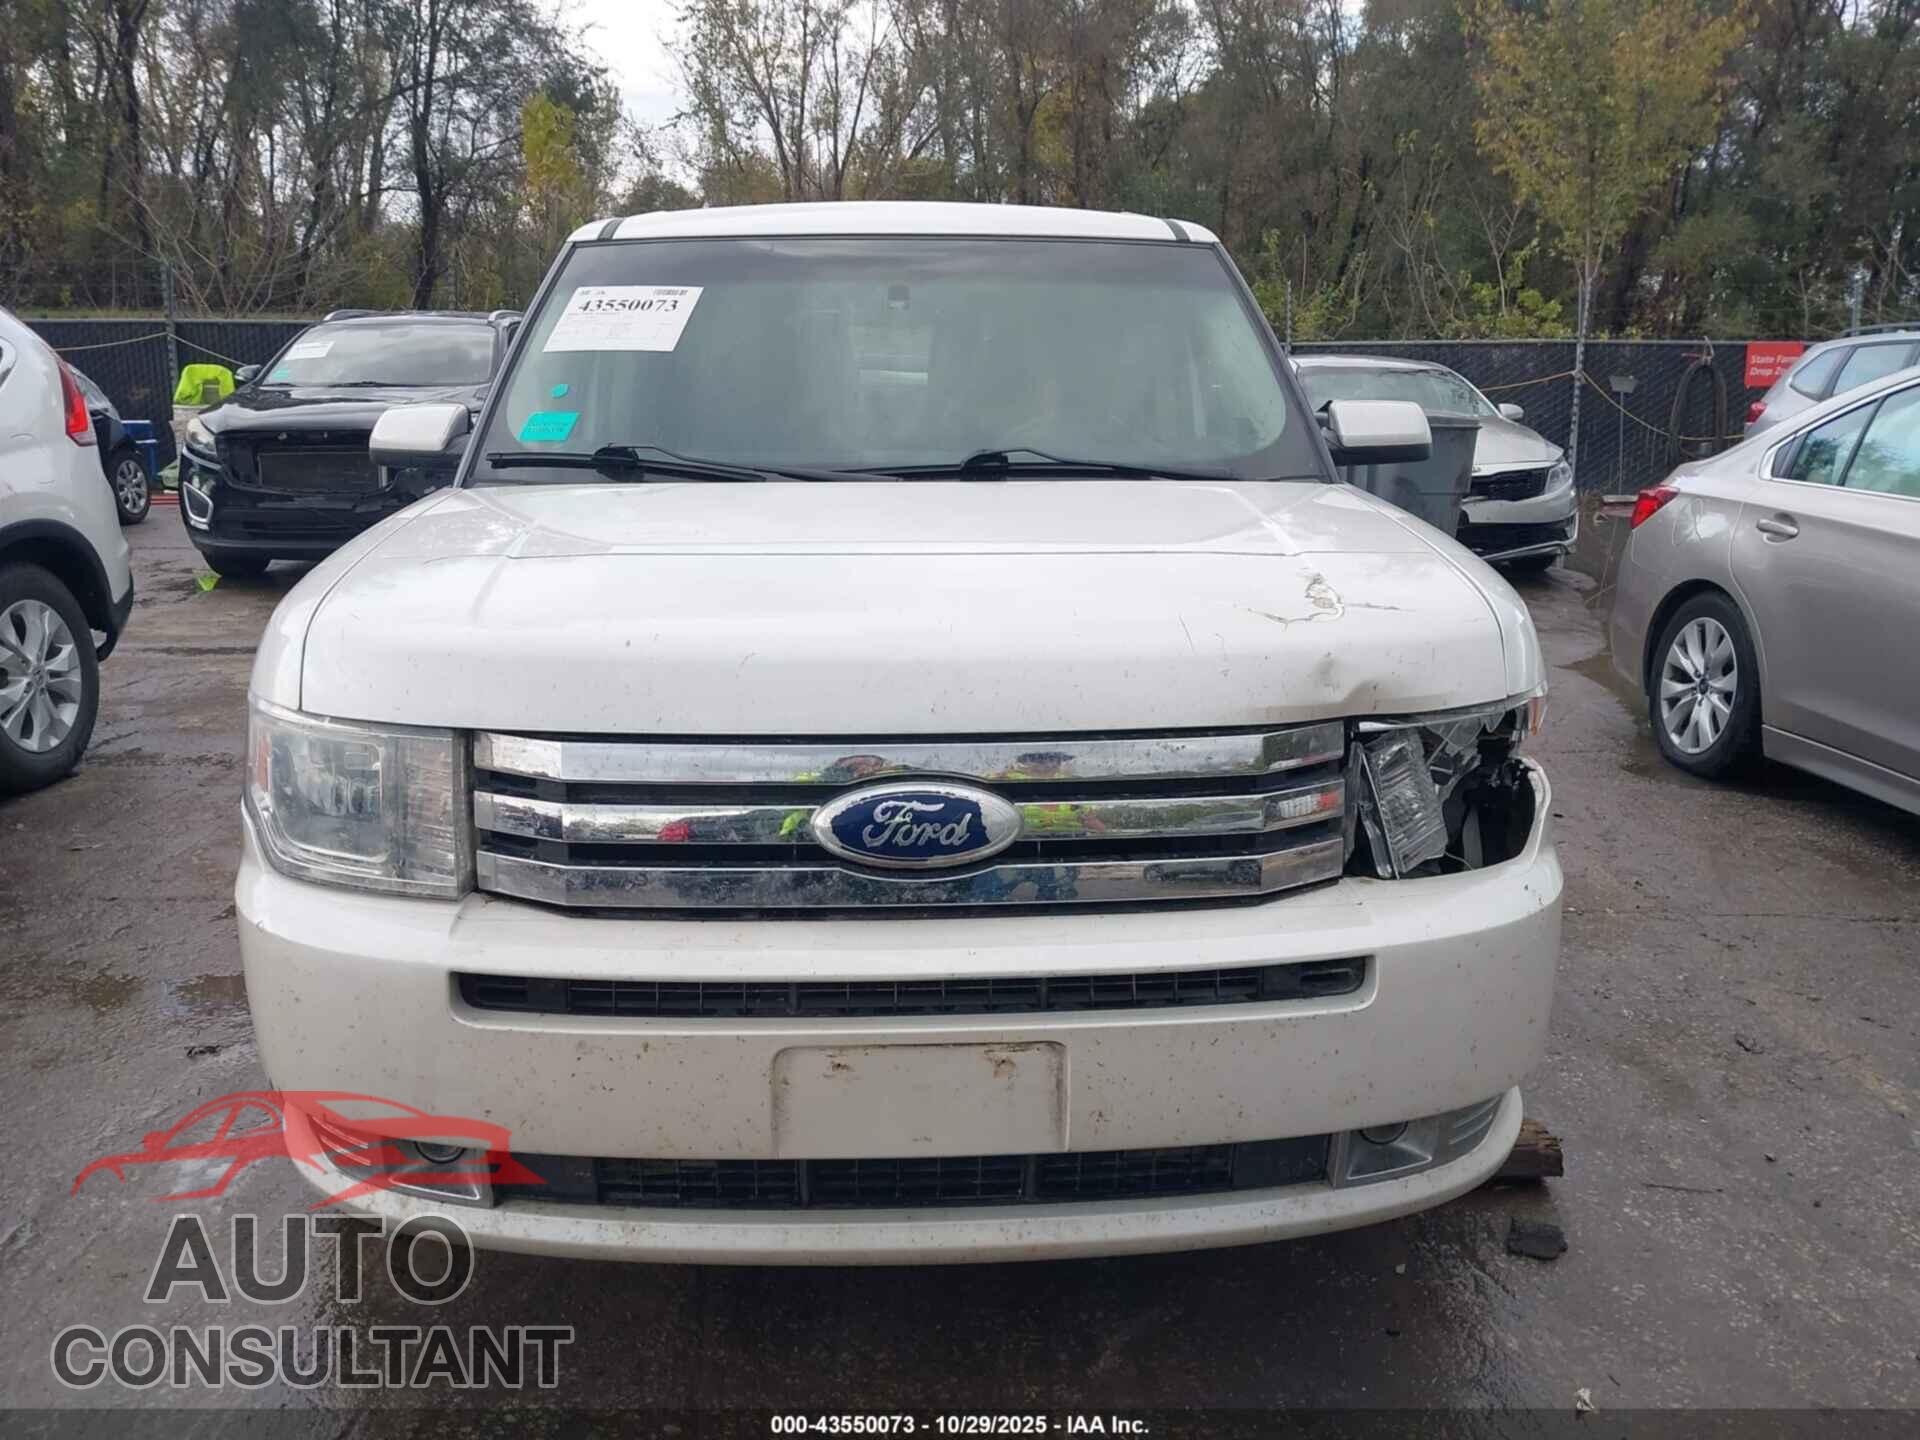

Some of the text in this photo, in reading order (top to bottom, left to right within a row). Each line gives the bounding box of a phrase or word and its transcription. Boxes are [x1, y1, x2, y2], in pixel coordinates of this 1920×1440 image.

[578, 299, 679, 312] 43550073
[1751, 354, 1775, 364] State
[1750, 367, 1773, 377] Drop
[862, 800, 972, 848] Ford
